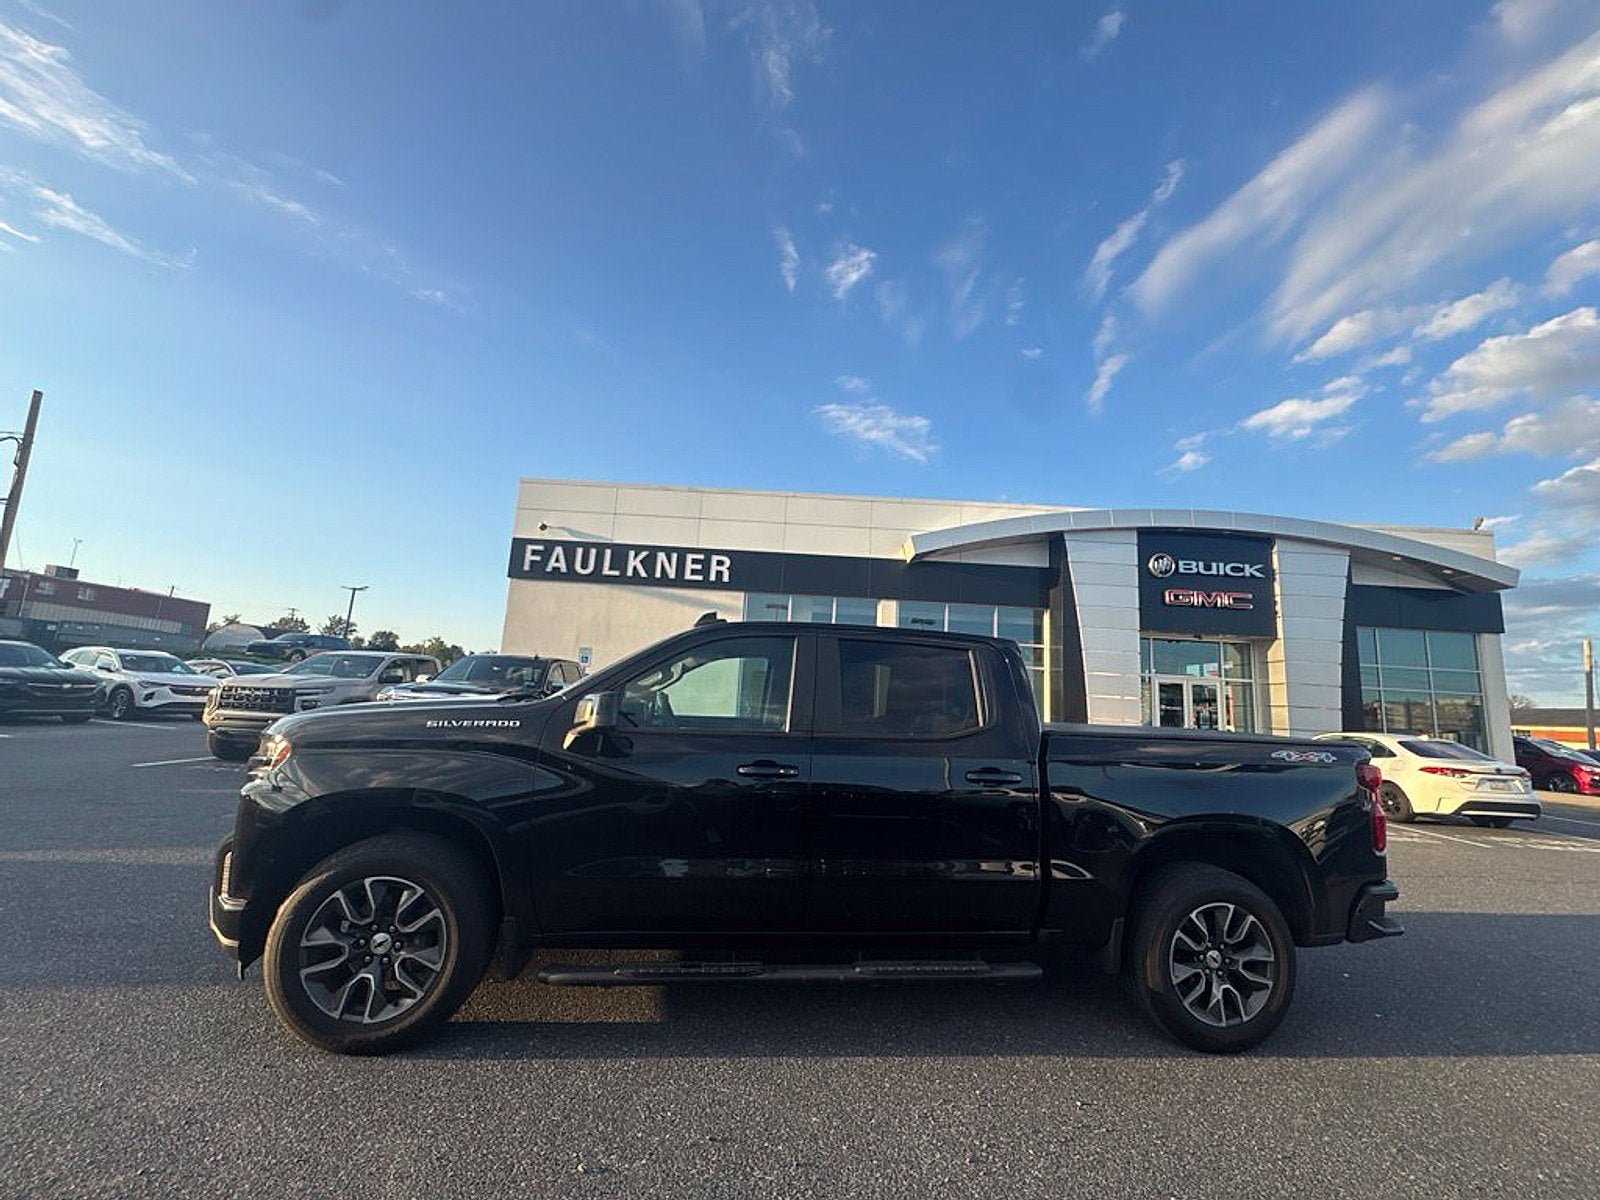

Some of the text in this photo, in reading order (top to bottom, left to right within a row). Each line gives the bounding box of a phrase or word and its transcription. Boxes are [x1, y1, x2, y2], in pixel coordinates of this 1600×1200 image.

[523, 544, 733, 583] FAULKNER
[1178, 560, 1265, 578] BUICK
[1164, 588, 1253, 610] GMC
